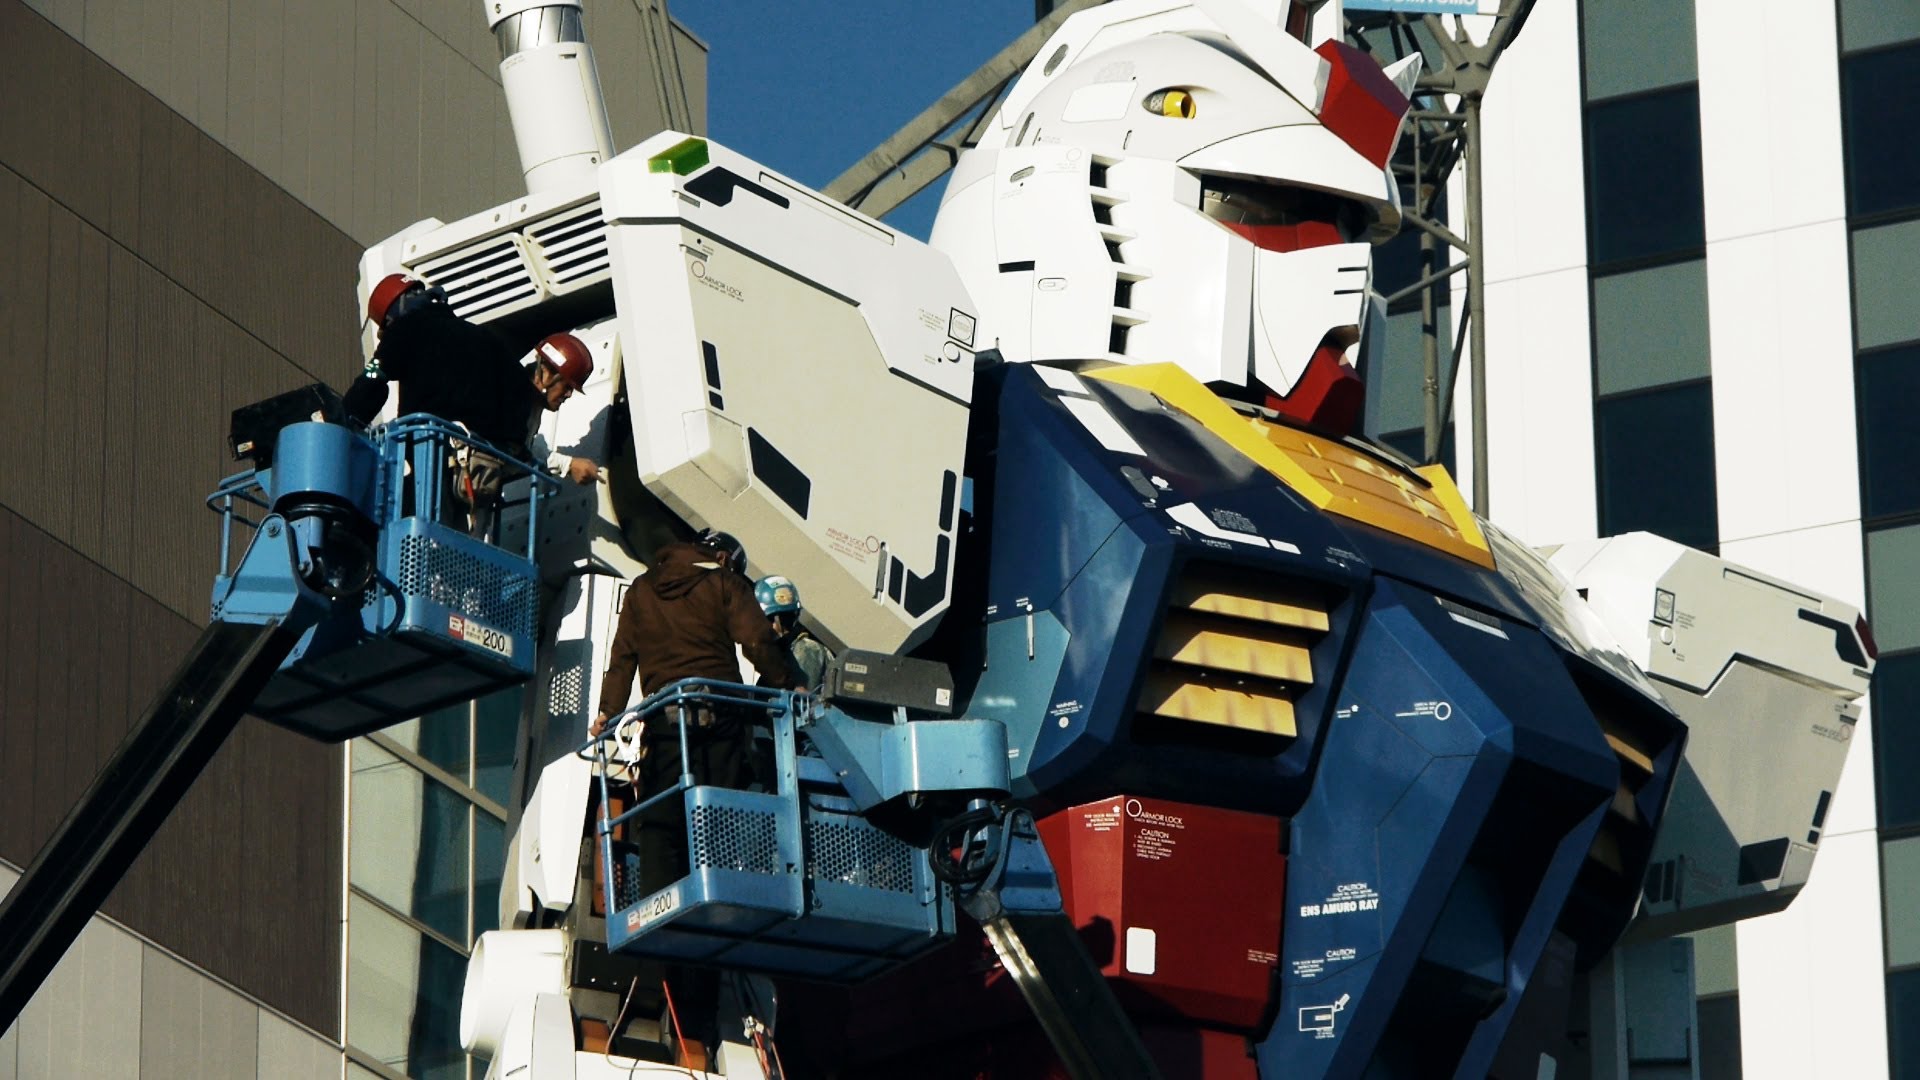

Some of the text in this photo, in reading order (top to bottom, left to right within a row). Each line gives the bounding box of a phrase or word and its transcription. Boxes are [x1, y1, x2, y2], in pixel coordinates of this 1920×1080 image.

[483, 629, 505, 652] 200
[1140, 811, 1164, 822] ARMOR
[1164, 815, 1183, 825] LOCK
[1140, 828, 1169, 839] CAUTION
[1337, 882, 1367, 893] CAUTION
[654, 891, 671, 916] 200
[1300, 898, 1379, 917] ENS AMURO RAY
[1326, 948, 1356, 958] CAUTION
